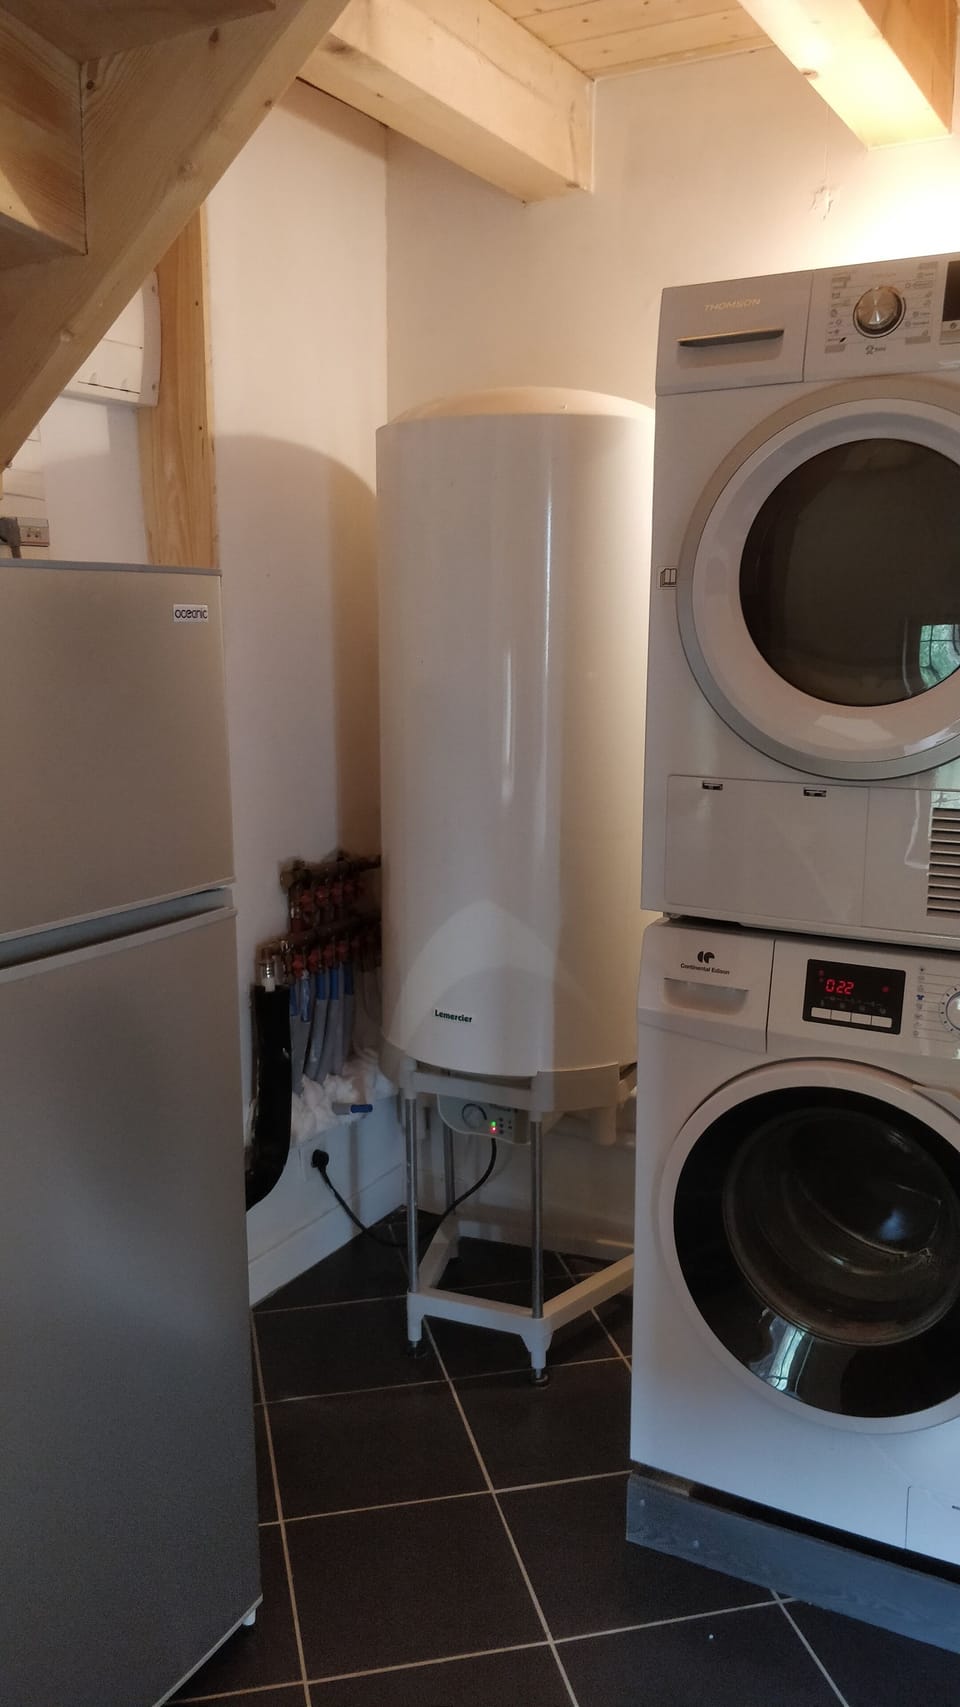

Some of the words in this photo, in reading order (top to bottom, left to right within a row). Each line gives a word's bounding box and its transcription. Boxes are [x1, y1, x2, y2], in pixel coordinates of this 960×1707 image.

[703, 298, 760, 311] THOMSON
[175, 608, 208, 619] oceanic
[435, 1009, 472, 1022] Lemercier
